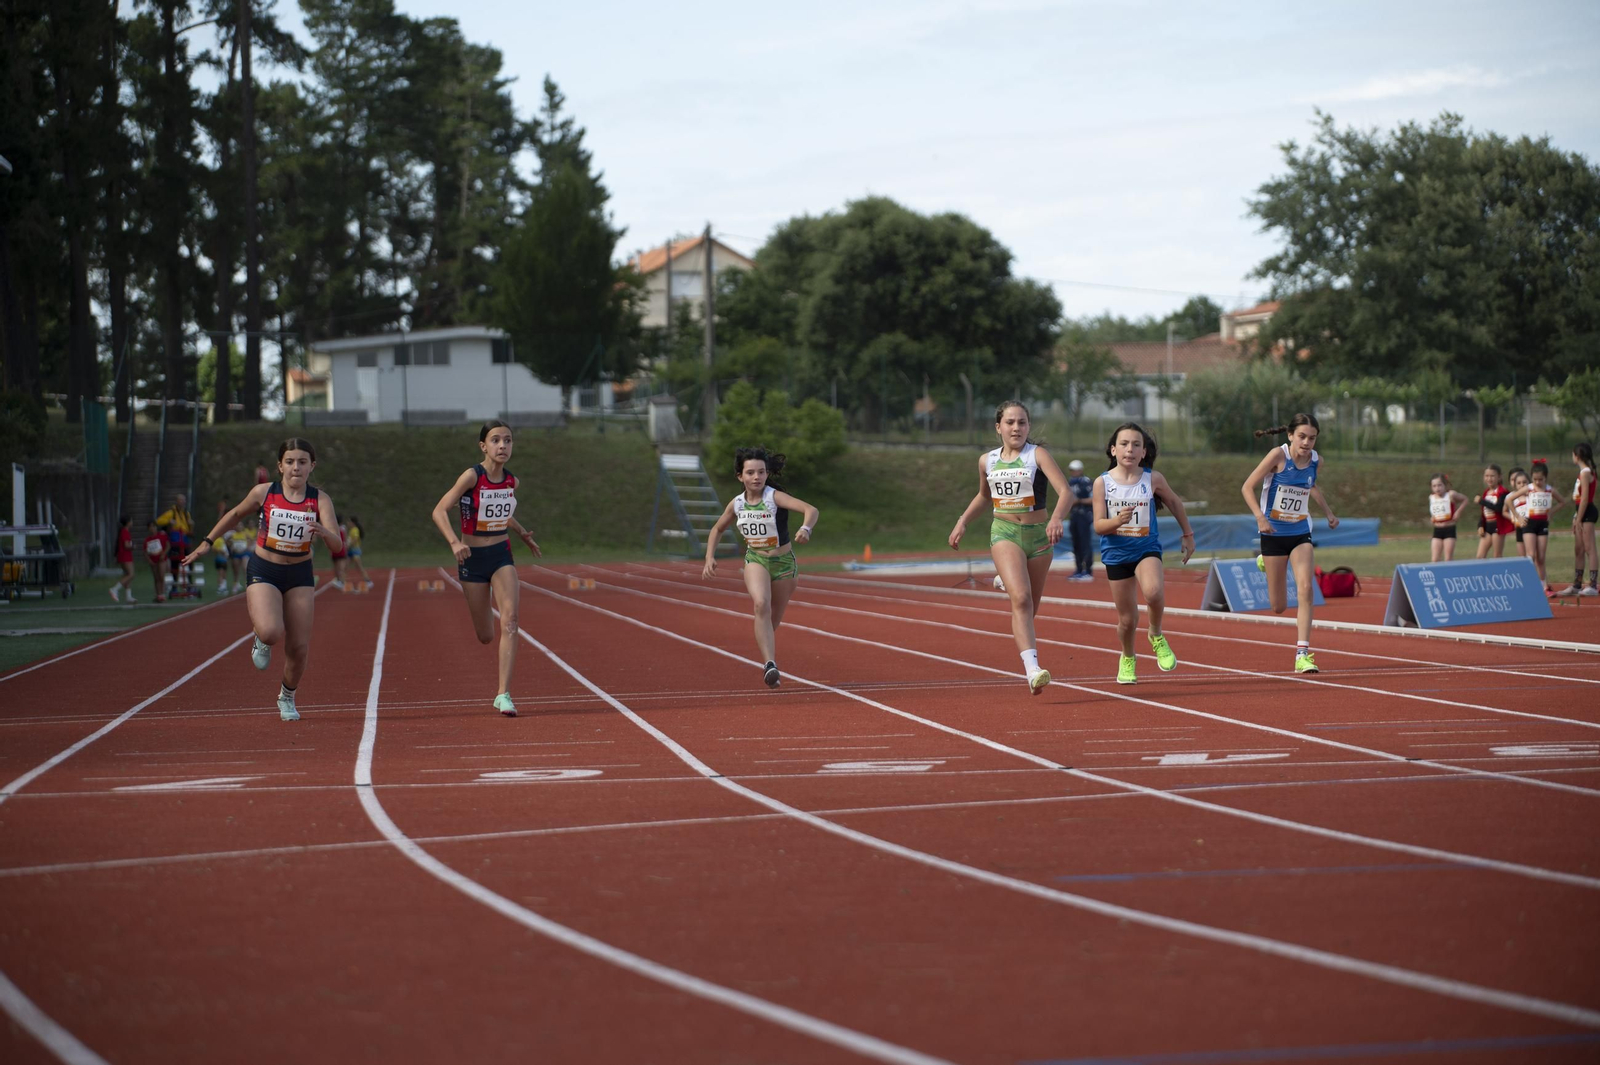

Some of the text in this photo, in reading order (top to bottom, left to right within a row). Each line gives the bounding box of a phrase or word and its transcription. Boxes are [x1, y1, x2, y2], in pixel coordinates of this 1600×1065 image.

[995, 481, 1021, 496] 687
[485, 503, 511, 518] 639
[1280, 497, 1302, 512] 570
[271, 510, 284, 518] La
[276, 523, 304, 540] 614
[741, 523, 767, 536] 680
[1443, 569, 1524, 594] DEPUTACIÓN
[1452, 595, 1512, 615] OURENSE
